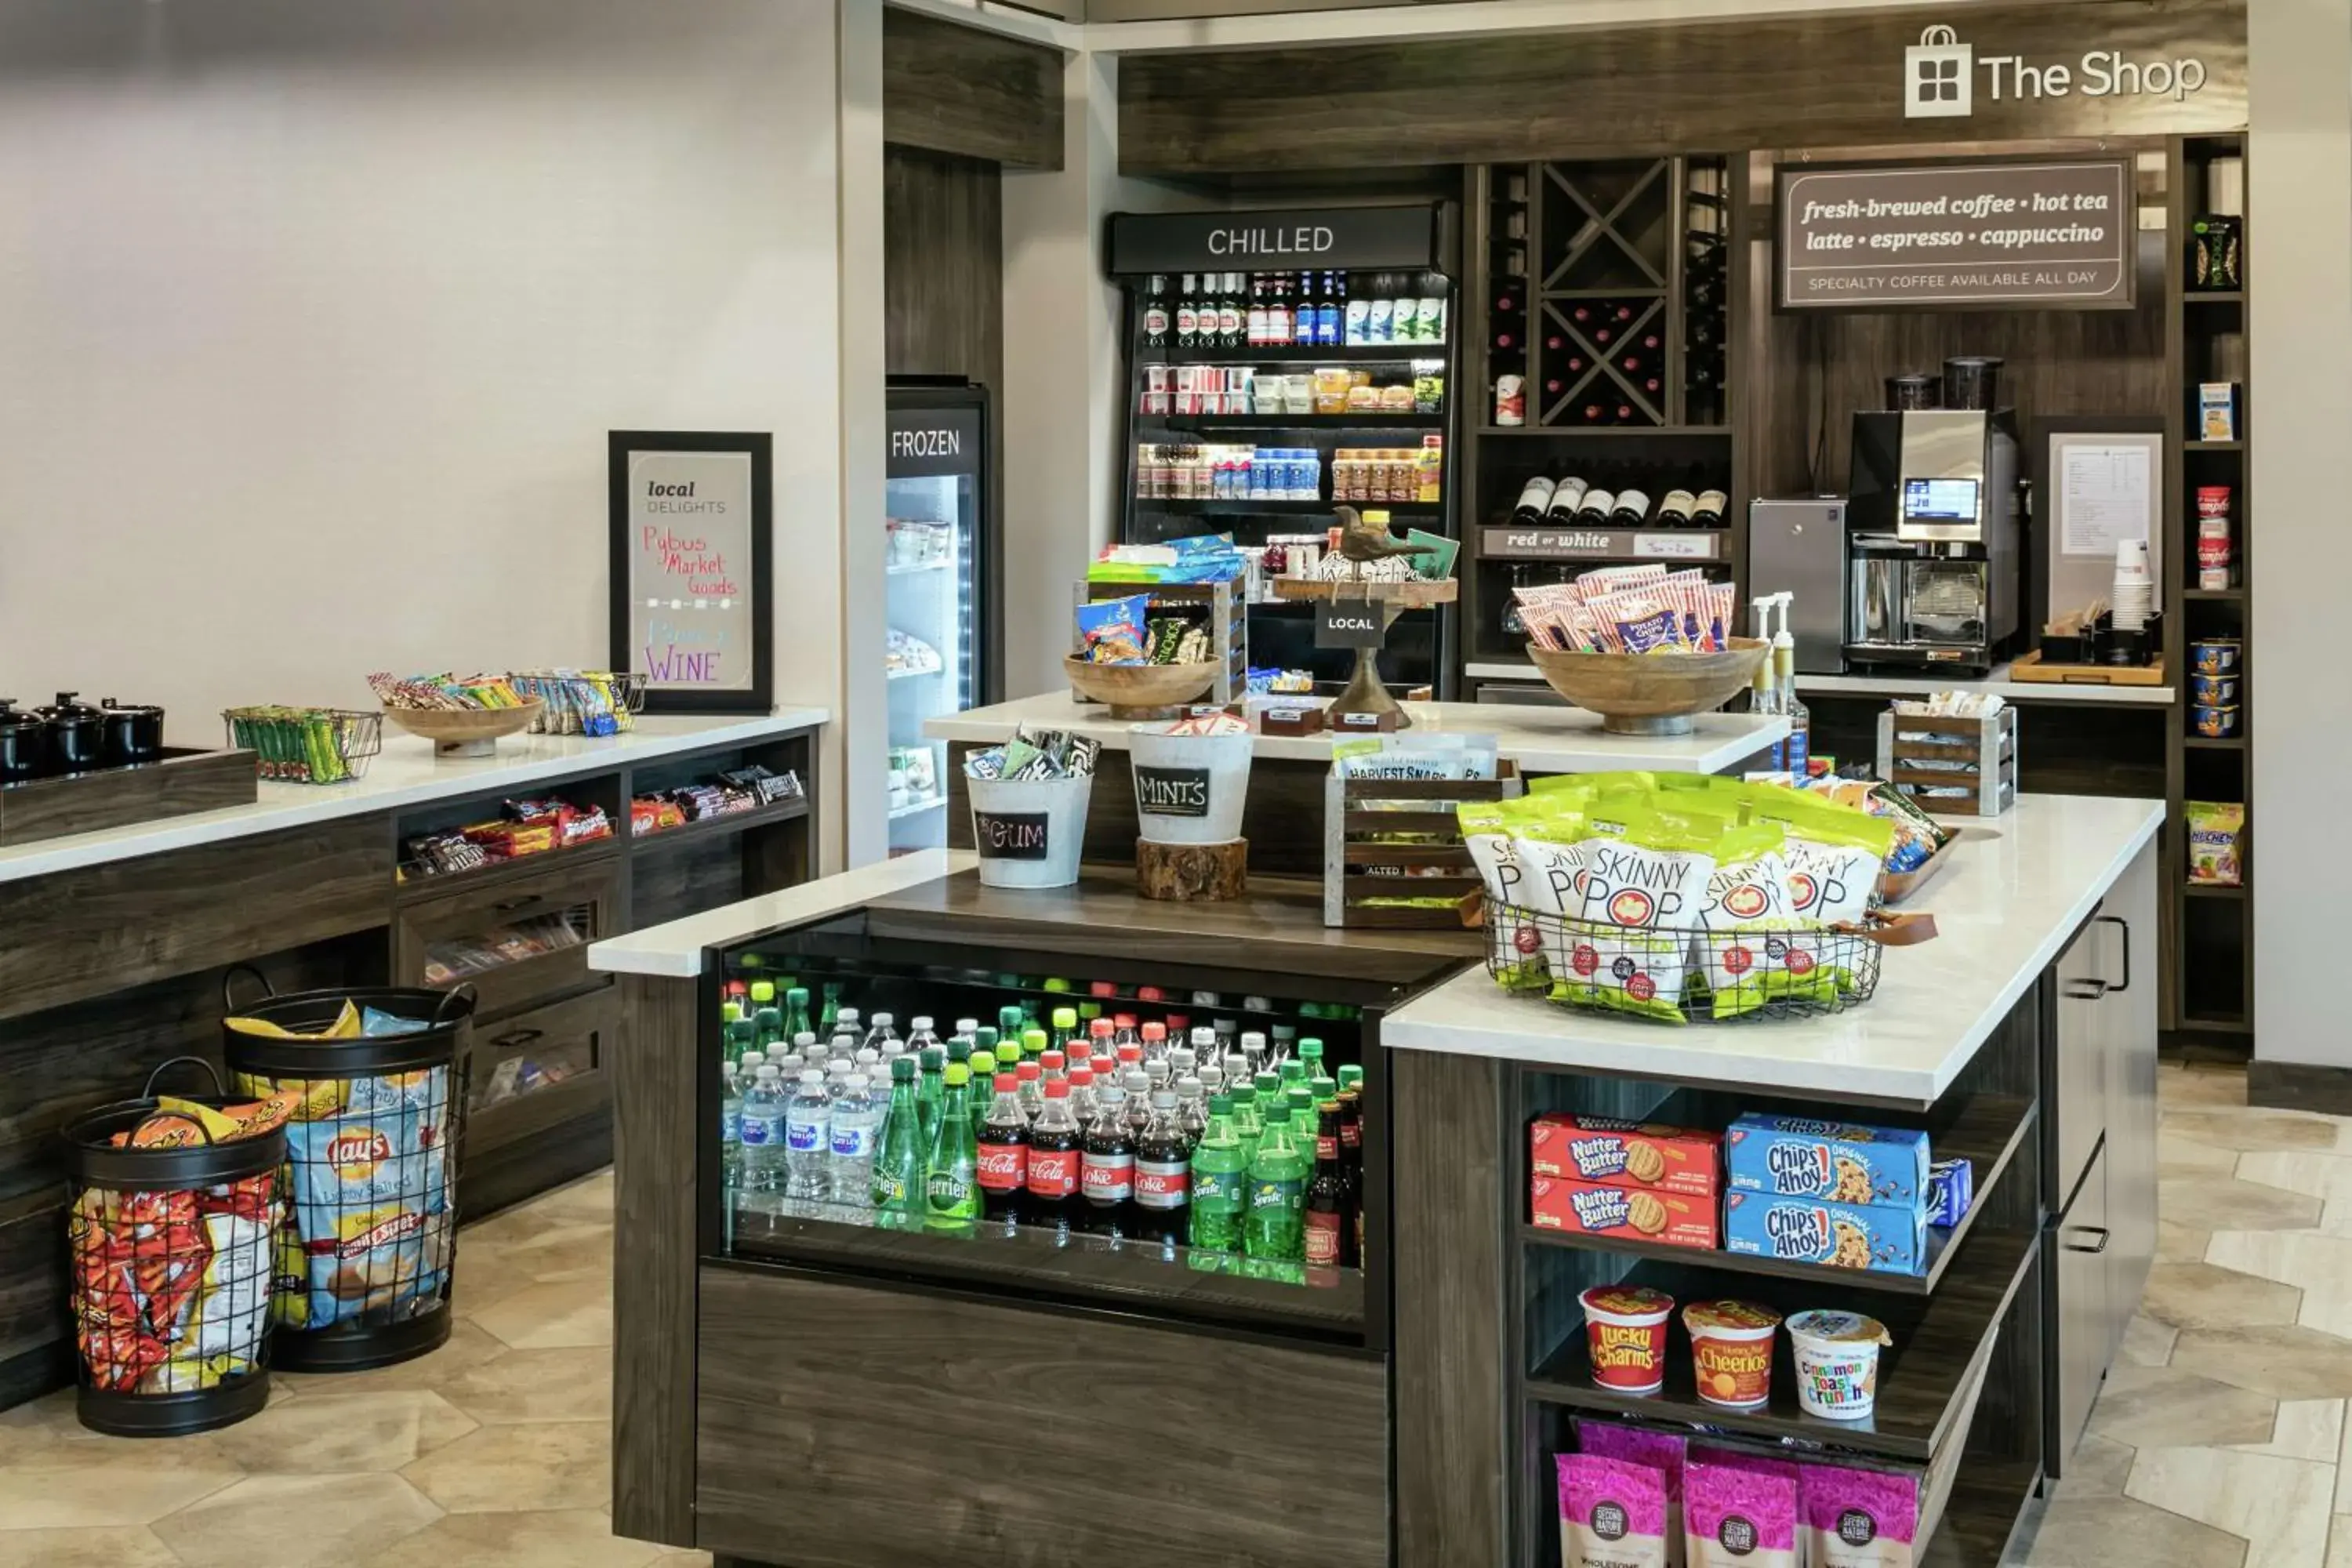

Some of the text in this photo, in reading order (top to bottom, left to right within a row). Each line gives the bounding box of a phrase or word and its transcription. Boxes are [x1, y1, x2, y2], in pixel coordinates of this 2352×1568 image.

[1979, 51, 2207, 100] The Shop
[1800, 192, 2109, 224] fresh-brewed coffee hot tea
[1207, 227, 1334, 255] CHILLED
[1806, 223, 2105, 251] latte espresso cappuccino
[1808, 271, 2098, 291] SPECIALTY COFFEE AVAILABLE ALL DAY
[892, 430, 960, 457] FROZEN
[648, 480, 696, 497] local
[647, 500, 727, 514] DELIGHTS
[642, 525, 707, 566] Pybus
[1507, 532, 1538, 546] red
[1557, 532, 1610, 548] white
[665, 551, 726, 575] Market
[1329, 617, 1374, 630] LOCAL
[644, 644, 721, 683] WINE
[989, 820, 1044, 848] GUM
[1570, 1137, 1621, 1160] Nutter
[1768, 1145, 1814, 1174] Chips
[1579, 1151, 1628, 1175] Butter
[1571, 1189, 1624, 1212] Nutter
[1581, 1203, 1630, 1227] Butter
[1766, 1209, 1817, 1237] Chips
[1600, 1326, 1652, 1348] Lucky
[1596, 1345, 1654, 1370] Charms
[1701, 1348, 1766, 1373] Cheerios
[1802, 1361, 1862, 1377] Cinnamon
[1807, 1385, 1862, 1404] Crunch
[1812, 1375, 1852, 1390] Toast
